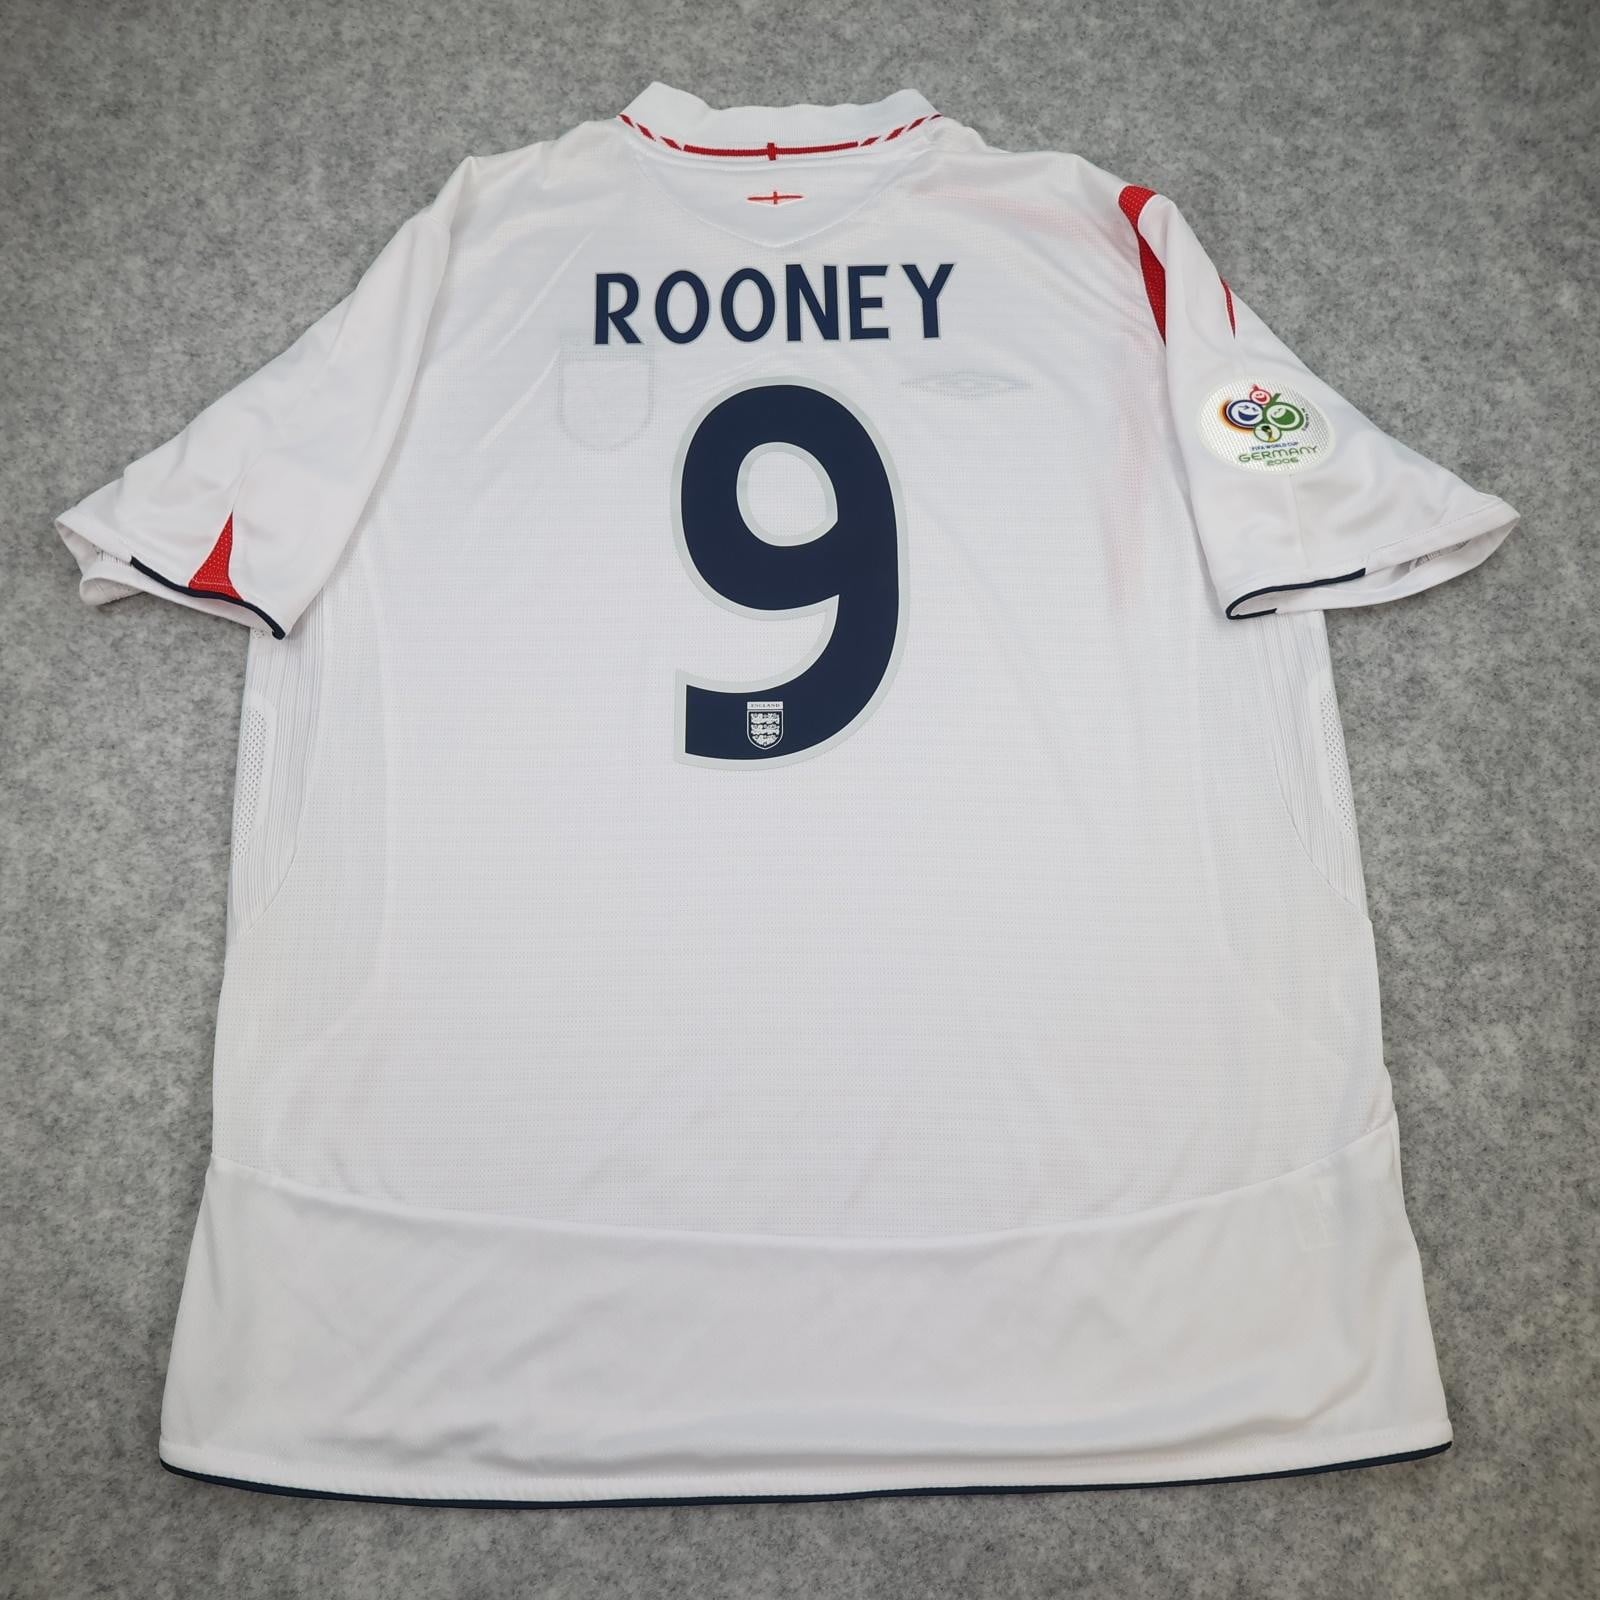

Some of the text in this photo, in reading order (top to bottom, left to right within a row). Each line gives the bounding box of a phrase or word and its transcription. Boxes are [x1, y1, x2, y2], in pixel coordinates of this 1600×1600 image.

[594, 263, 955, 345] ROONEY
[1238, 445, 1318, 463] GERMANY
[1266, 457, 1299, 466] 2006
[679, 384, 902, 761] 9
